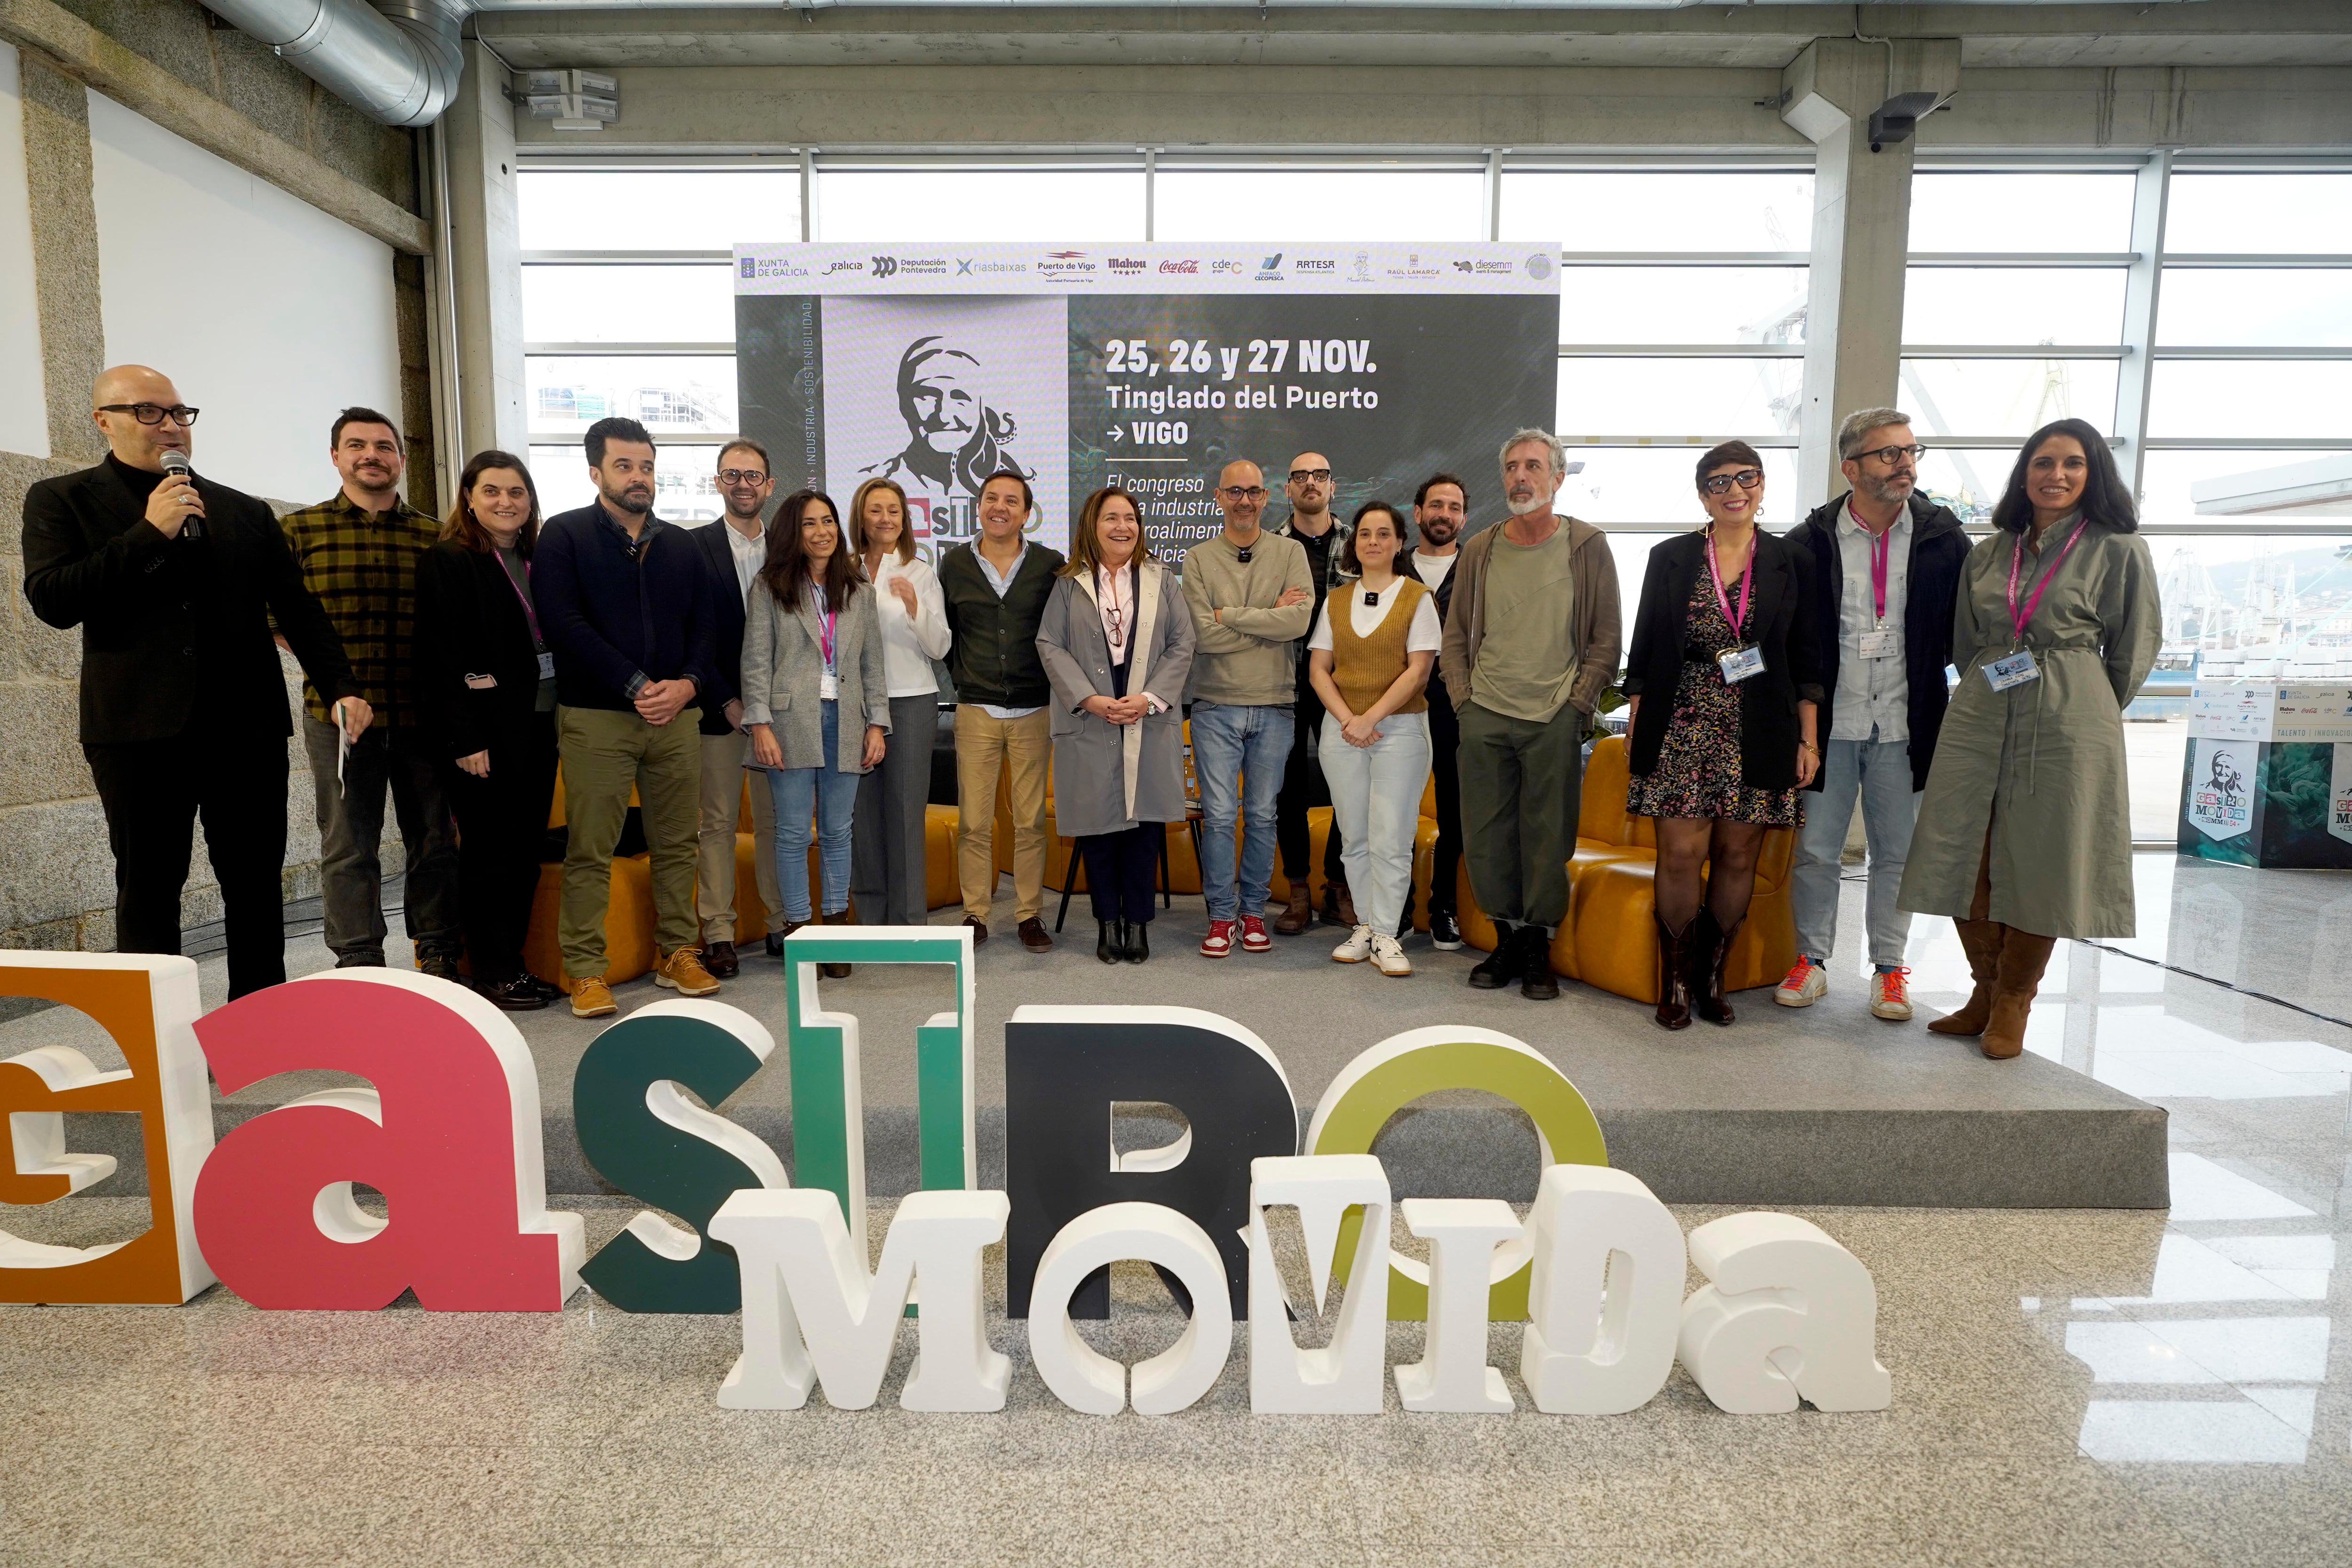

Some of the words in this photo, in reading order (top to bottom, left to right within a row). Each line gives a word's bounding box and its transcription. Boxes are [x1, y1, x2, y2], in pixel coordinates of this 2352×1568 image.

[828, 260, 863, 274] galicia
[901, 258, 946, 267] Deputación
[974, 262, 1026, 271] ríasbaixas
[1078, 263, 1096, 271] Vigo
[1108, 258, 1147, 269] Mahou
[1296, 260, 1335, 269] ARTESA
[772, 268, 809, 277] GALICIA
[802, 302, 814, 395] SOSTENIBILIDAD
[1105, 339, 1160, 377] 25,
[1169, 339, 1212, 373] 26
[1220, 348, 1240, 381] y
[1248, 339, 1289, 373] 27
[1298, 339, 1377, 373] NOV.
[1105, 384, 1226, 415] Tinglado
[1234, 384, 1277, 409] del
[1286, 386, 1378, 409] Puerto
[806, 406, 817, 465] INDUSTRIA
[1132, 421, 1189, 445] VIGO
[1127, 477, 1204, 497] congreso
[1151, 497, 1224, 517] industria
[2314, 729, 2352, 738] INNOVACIO
